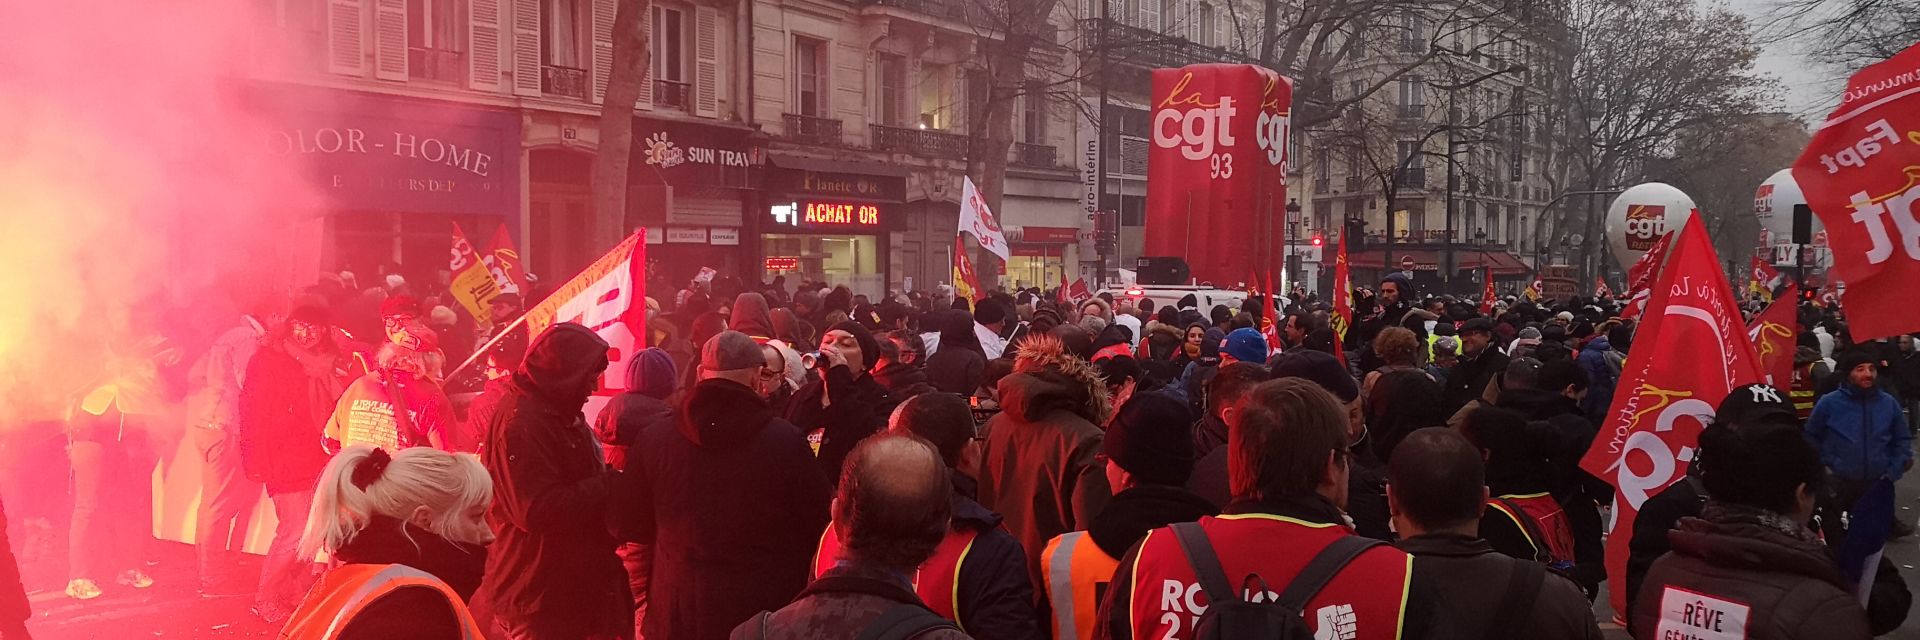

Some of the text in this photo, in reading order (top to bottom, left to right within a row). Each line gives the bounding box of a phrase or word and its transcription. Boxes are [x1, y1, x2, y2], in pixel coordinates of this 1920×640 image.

[1158, 72, 1236, 108] la
[1154, 96, 1236, 160] cgt
[1256, 107, 1291, 165] cgt
[264, 128, 367, 155] OLOR
[393, 132, 491, 177] HOME
[688, 147, 715, 164] SUN
[1211, 153, 1233, 179] 93
[1085, 140, 1096, 220] aéro-intérim
[1280, 161, 1287, 186] 9
[805, 203, 878, 225] ACHAT OR
[1625, 214, 1664, 239] cgt
[1682, 600, 1724, 632] RÊVE
